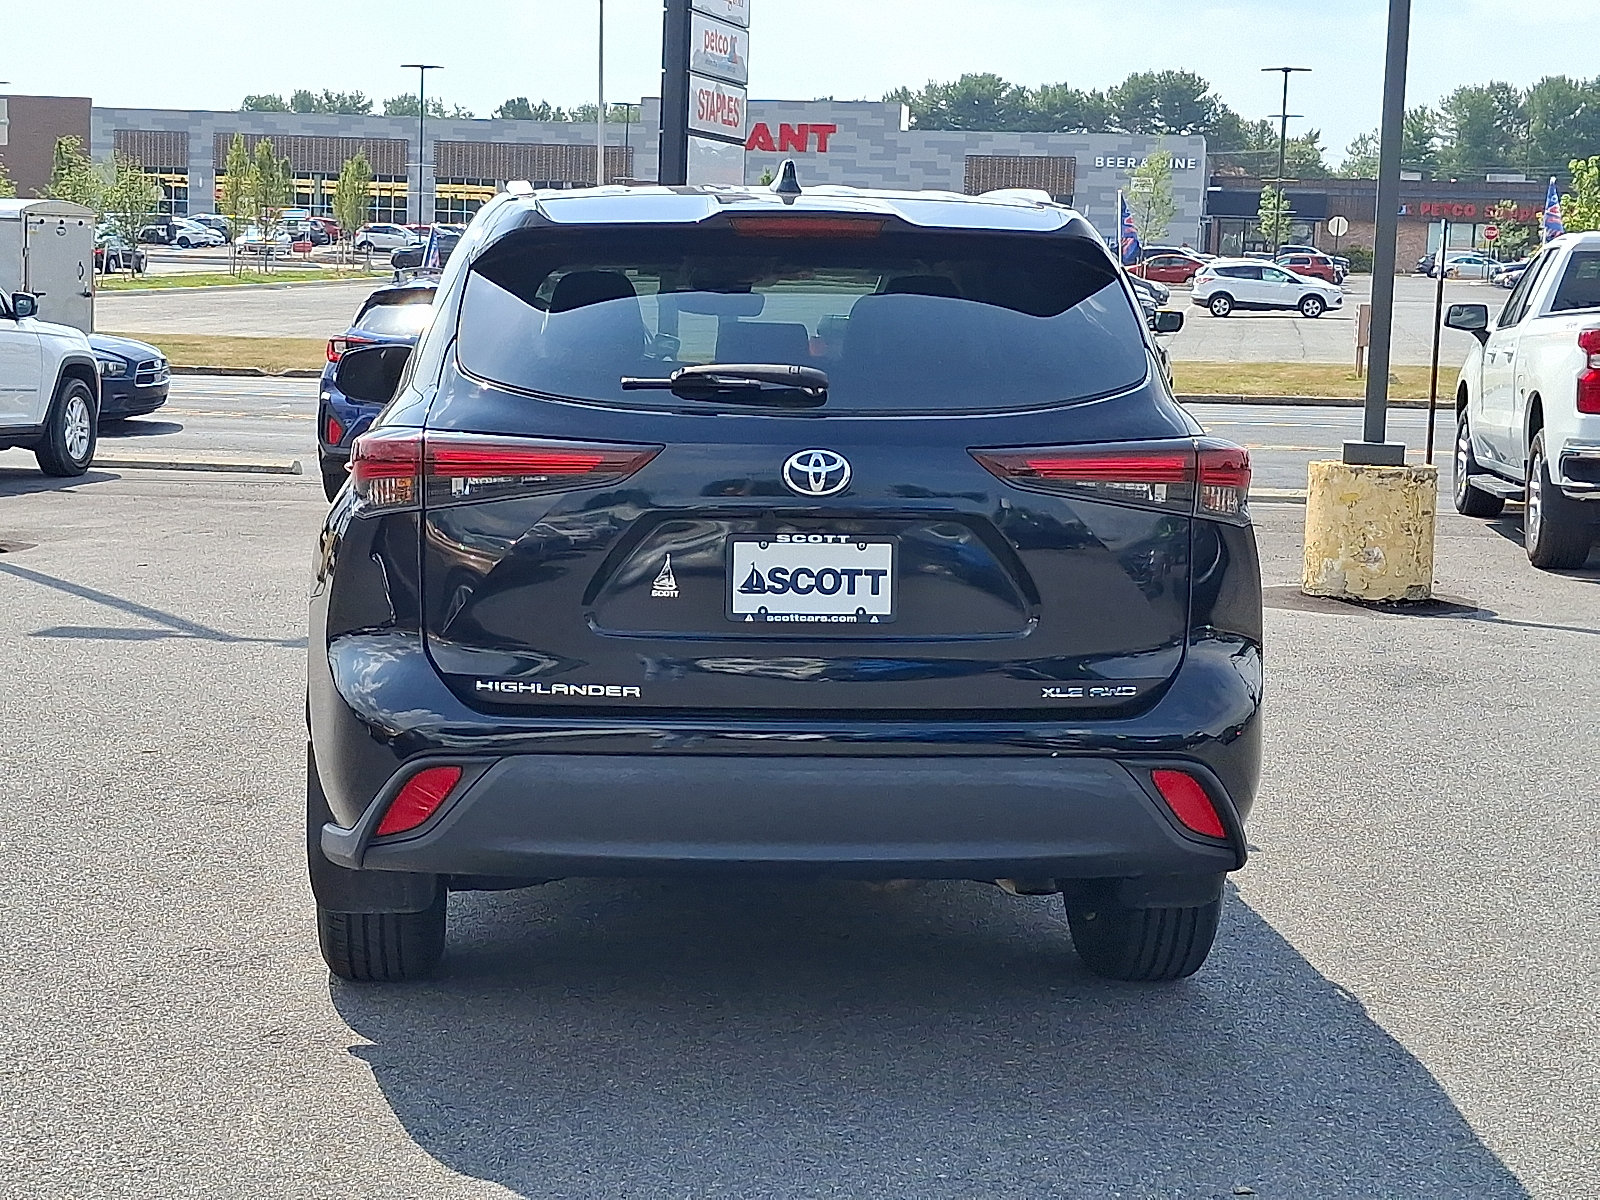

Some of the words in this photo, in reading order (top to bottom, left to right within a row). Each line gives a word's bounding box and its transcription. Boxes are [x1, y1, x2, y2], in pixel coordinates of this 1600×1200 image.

[703, 29, 728, 55] petco
[698, 88, 739, 128] STAPLES
[1095, 156, 1138, 168] BEER
[1420, 202, 1477, 217] PETCO
[776, 534, 851, 544] SCOTT
[767, 567, 888, 596] SCOTT
[651, 590, 680, 598] SCOTT
[766, 614, 858, 624] scottcars.com
[475, 680, 642, 698] HIGHLANDER
[1041, 687, 1084, 698] XLE
[1089, 686, 1137, 698] AWD
